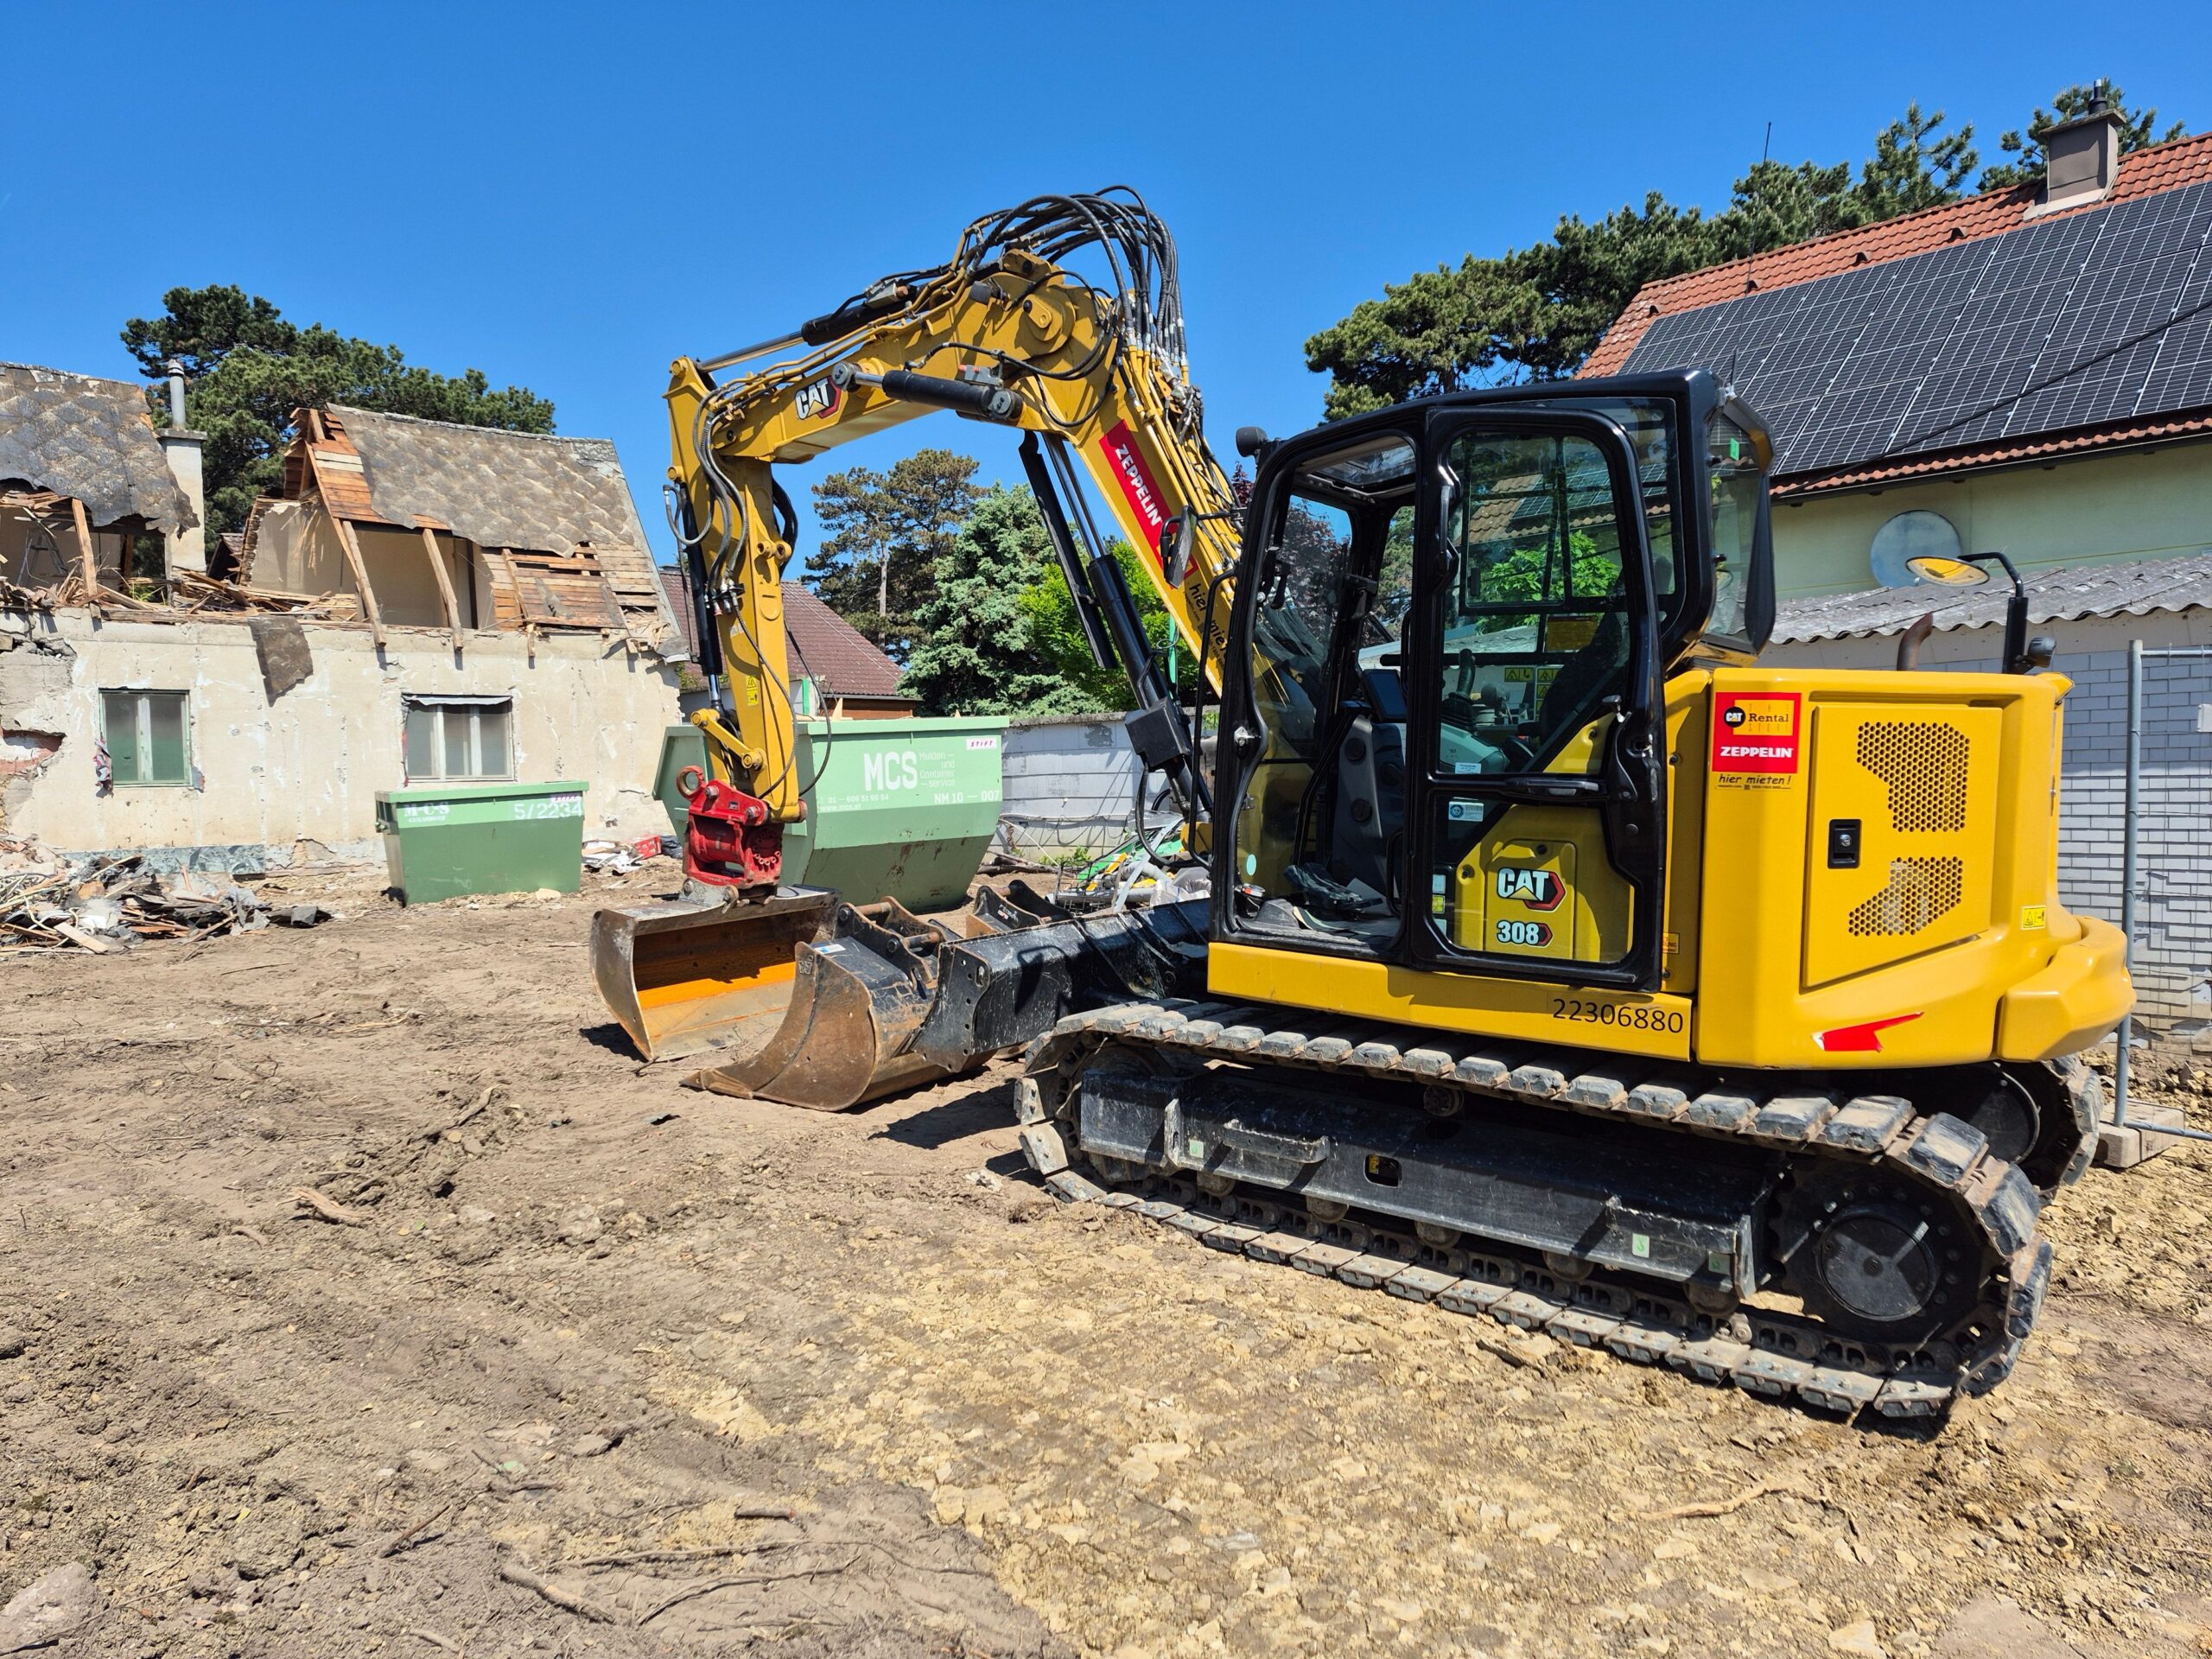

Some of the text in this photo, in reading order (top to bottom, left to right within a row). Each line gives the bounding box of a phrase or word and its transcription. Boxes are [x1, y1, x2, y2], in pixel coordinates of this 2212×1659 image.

[795, 378, 830, 420] CAT
[1115, 443, 1163, 526] ZEPPELIN
[1725, 712, 1789, 722] CAT Rental
[1719, 747, 1792, 758] ZEPPELIN
[863, 751, 918, 791] MCS
[941, 759, 955, 768] und
[919, 769, 956, 779] Container
[1719, 773, 1742, 784] hier
[934, 792, 950, 804] NM
[952, 791, 964, 804] 10
[981, 790, 1000, 802] 007
[513, 802, 583, 819] 5/2234
[1497, 868, 1549, 902] CAT
[1497, 921, 1540, 944] 308
[1552, 998, 1684, 1033] 22306880
